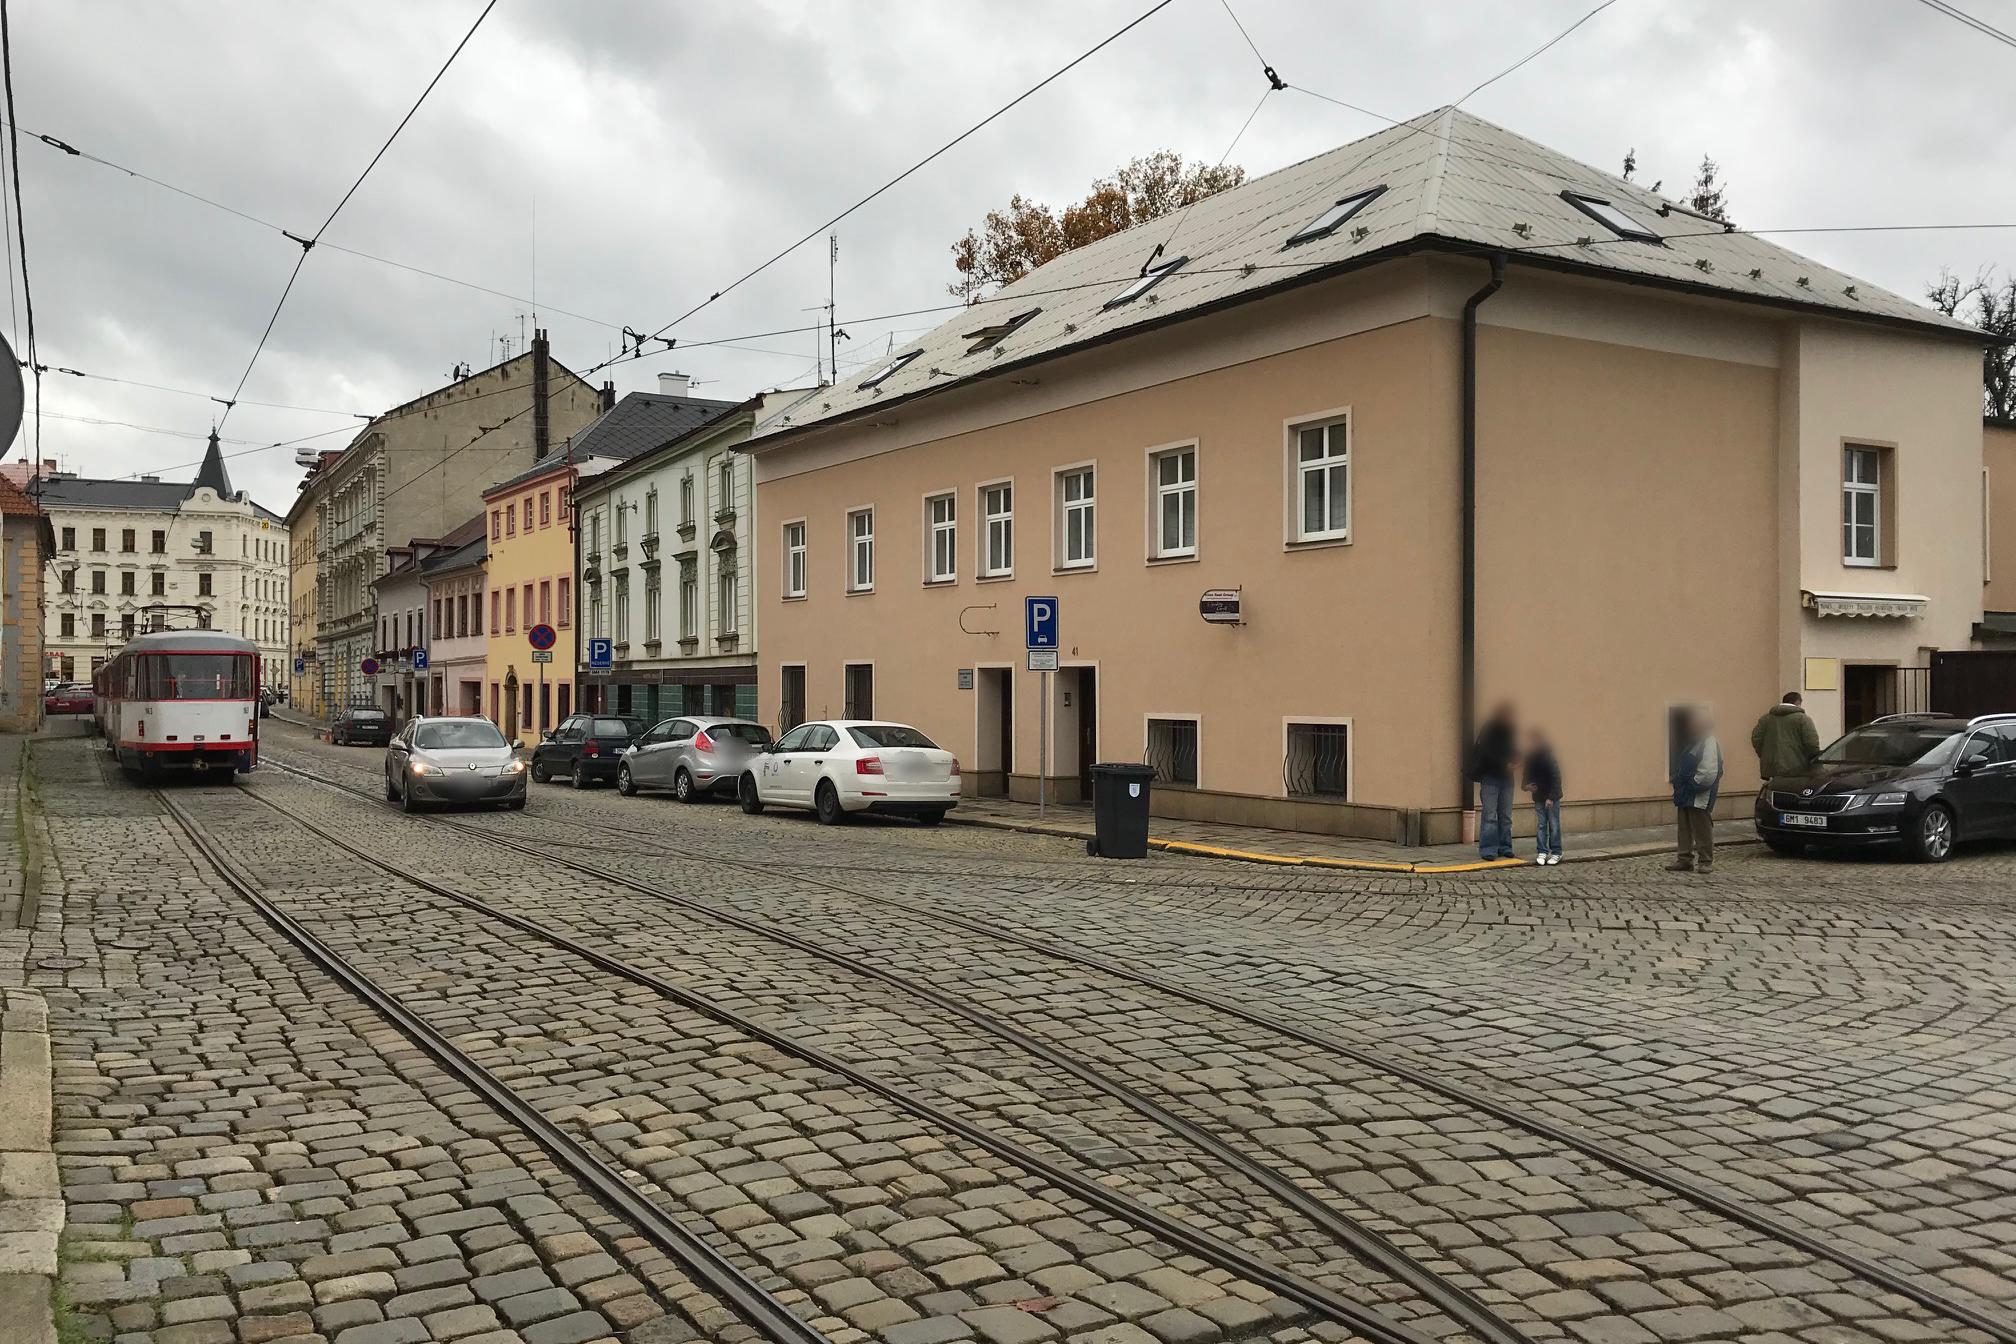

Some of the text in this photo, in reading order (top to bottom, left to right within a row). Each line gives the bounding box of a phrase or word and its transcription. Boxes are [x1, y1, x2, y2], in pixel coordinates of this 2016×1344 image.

[1033, 603, 1051, 632] P
[594, 642, 607, 659] P
[1071, 646, 1079, 656] 41
[416, 652, 425, 663] P
[1785, 814, 1824, 825] 6M1 9483
